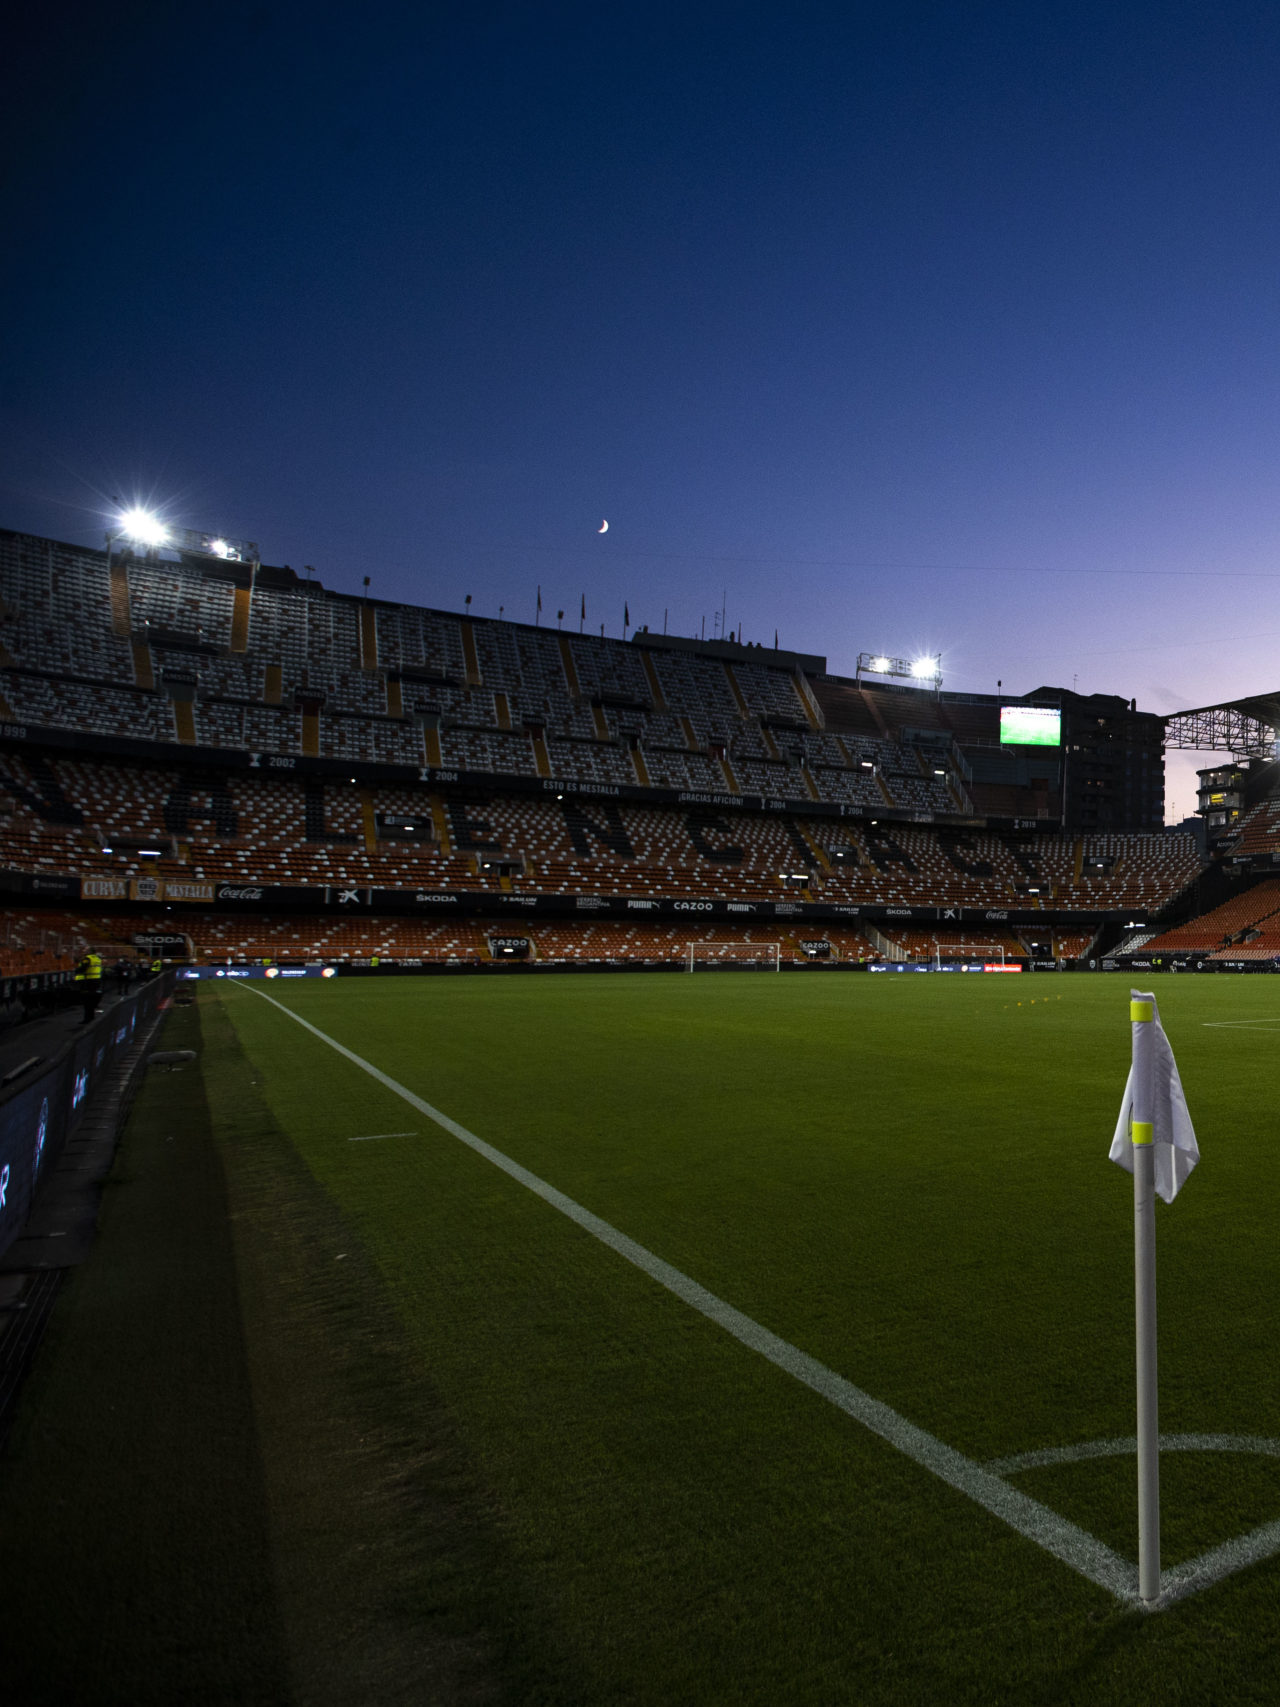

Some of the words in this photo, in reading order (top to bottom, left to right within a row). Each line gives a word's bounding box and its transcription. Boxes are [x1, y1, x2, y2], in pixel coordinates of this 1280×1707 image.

[269, 757, 296, 768] 2002
[435, 771, 459, 781] 2004
[543, 780, 565, 790] ESTO
[567, 782, 577, 791] ES
[579, 784, 620, 795] MESTALLA
[84, 880, 128, 897] CURVA
[166, 883, 214, 899] MESTALLA
[416, 894, 458, 903] ŠKODA
[628, 900, 652, 909] PUMA
[673, 902, 713, 910] CAZOO
[727, 903, 750, 912] PUMA
[886, 908, 912, 916] ŠKODA
[136, 935, 185, 944] ŠKODA
[491, 938, 528, 947] CAZOO
